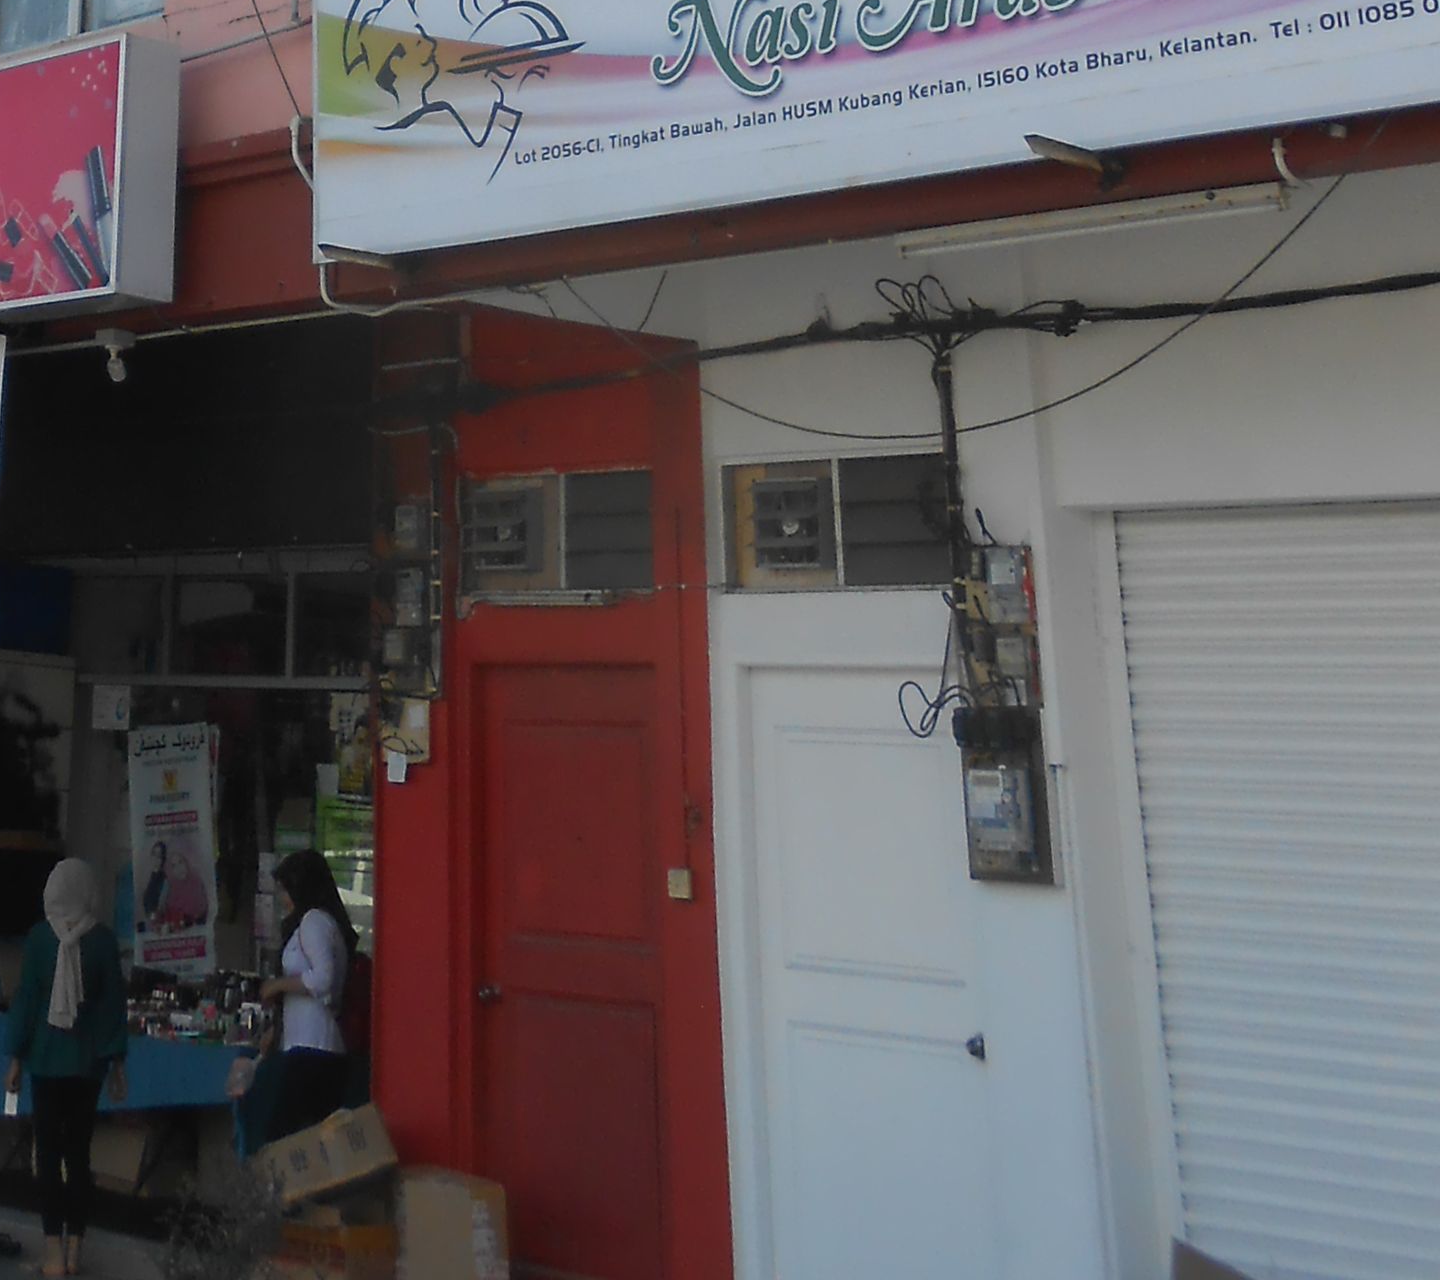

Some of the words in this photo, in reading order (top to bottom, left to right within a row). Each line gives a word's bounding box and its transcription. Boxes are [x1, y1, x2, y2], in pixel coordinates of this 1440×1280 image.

[515, 149, 537, 165] Lot
[609, 126, 666, 151] Tingkat
[670, 117, 729, 140] Bawah,
[733, 109, 777, 130] Jalan
[782, 99, 833, 121] HUSM
[839, 87, 903, 112] Kubang
[908, 77, 972, 101] Kerian,
[977, 65, 1030, 89] 15160
[1035, 55, 1080, 80] Kota
[1085, 45, 1154, 71] Bharu,
[1159, 28, 1259, 58] Kelantan.
[1269, 19, 1300, 40] Tel
[1319, 10, 1350, 32] 011
